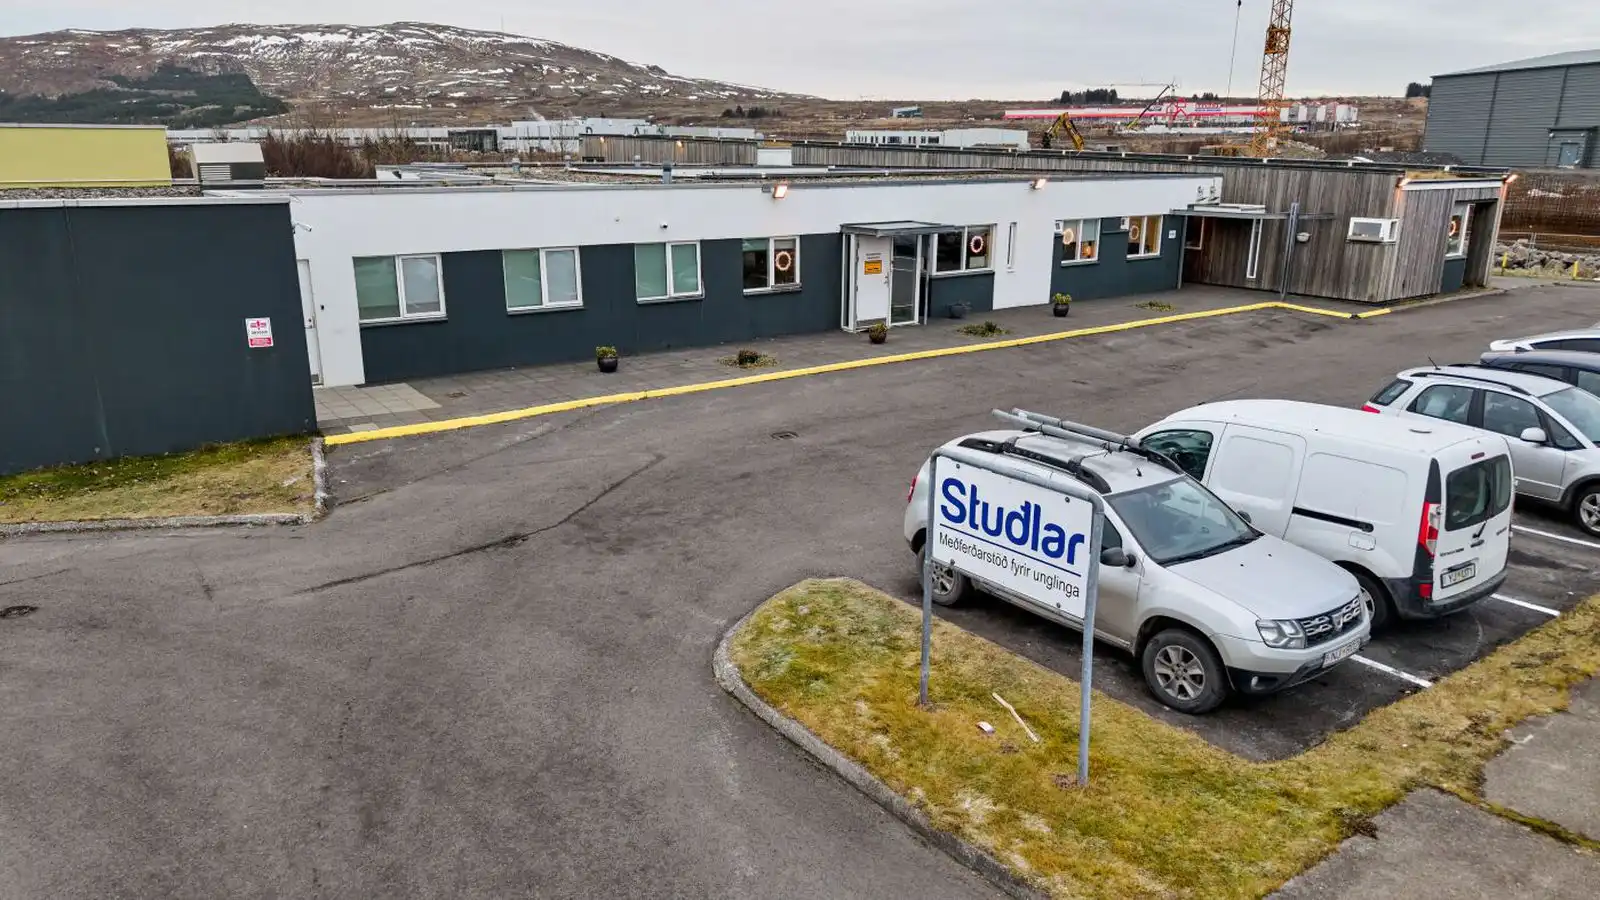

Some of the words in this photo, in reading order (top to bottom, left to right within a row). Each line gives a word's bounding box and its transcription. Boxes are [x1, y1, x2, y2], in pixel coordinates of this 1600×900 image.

[939, 532, 1008, 568] Meðferðarstöð
[1010, 558, 1031, 577] fyrir
[1033, 570, 1080, 598] unglinga
